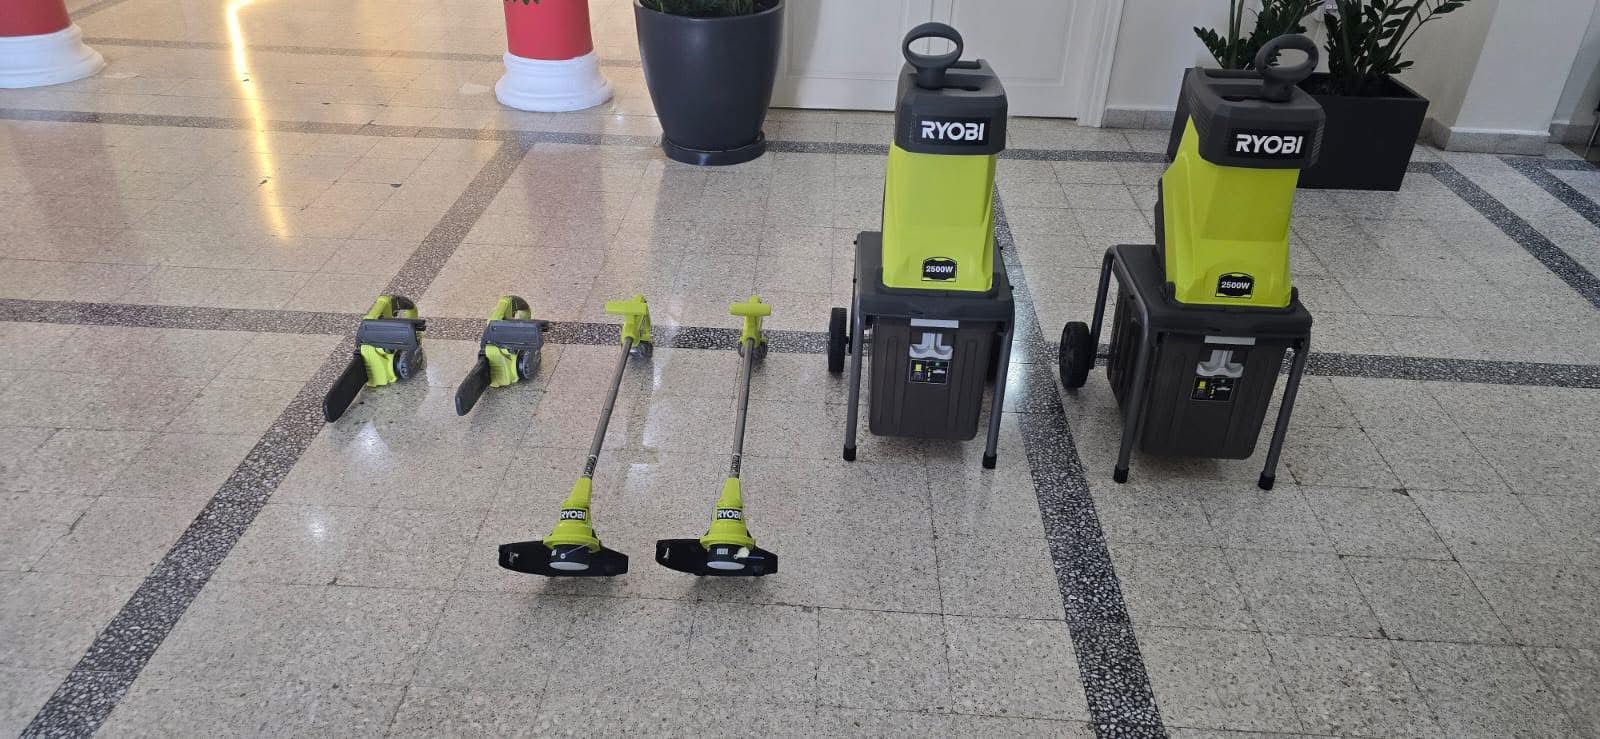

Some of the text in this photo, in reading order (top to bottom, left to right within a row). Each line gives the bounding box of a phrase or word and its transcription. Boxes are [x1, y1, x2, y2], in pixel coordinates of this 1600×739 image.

[921, 120, 985, 141] RYOBI
[1235, 133, 1304, 154] RYOBI
[925, 265, 954, 273] 2500W
[1221, 281, 1251, 290] 2500W
[560, 510, 586, 520] RYOBI
